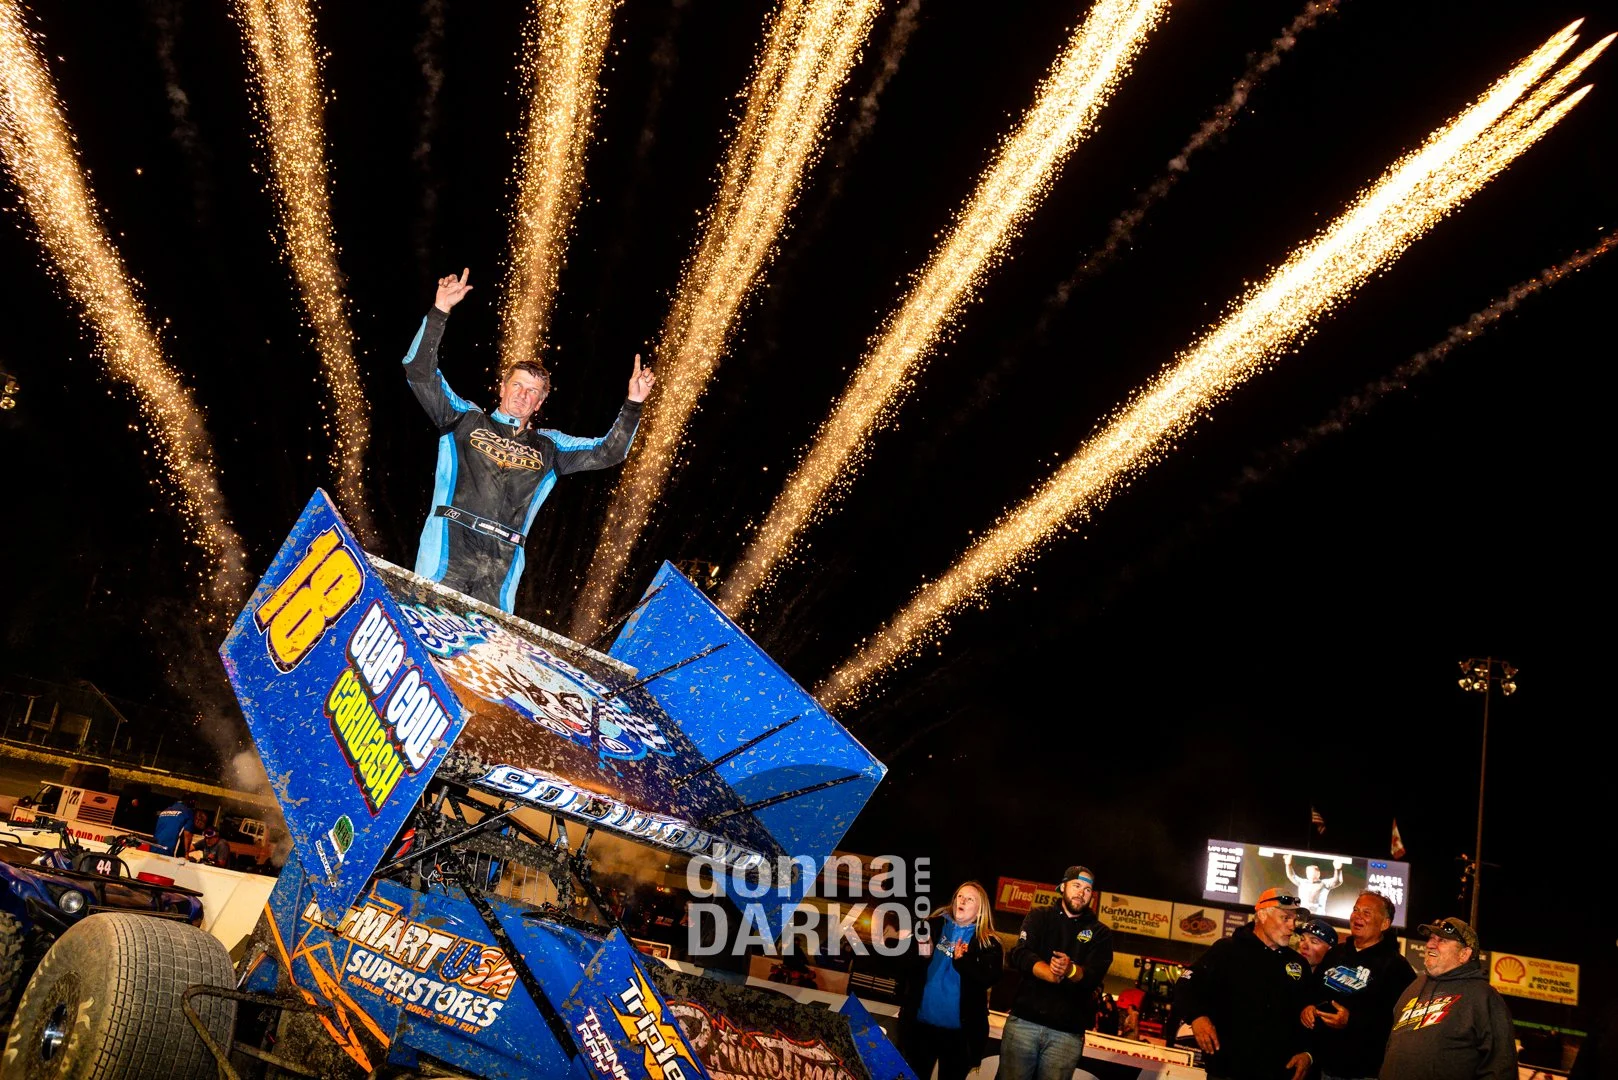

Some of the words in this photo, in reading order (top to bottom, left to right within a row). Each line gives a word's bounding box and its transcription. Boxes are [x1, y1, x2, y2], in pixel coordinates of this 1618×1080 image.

[253, 526, 365, 672] 18
[386, 668, 450, 771] COW
[96, 860, 111, 875] 44
[1011, 885, 1033, 902] Tires
[1034, 894, 1050, 905] LES
[346, 949, 504, 1027] SUPERSTORES
[347, 974, 385, 996] CHRYSLER
[405, 1002, 432, 1020] DODGE
[459, 1021, 482, 1035] FIAT
[1531, 976, 1571, 988] PROPANE
[1536, 983, 1548, 991] RV
[1550, 986, 1575, 995] DUMP
[576, 1022, 610, 1073] RAY
[620, 977, 687, 1080] Triple
